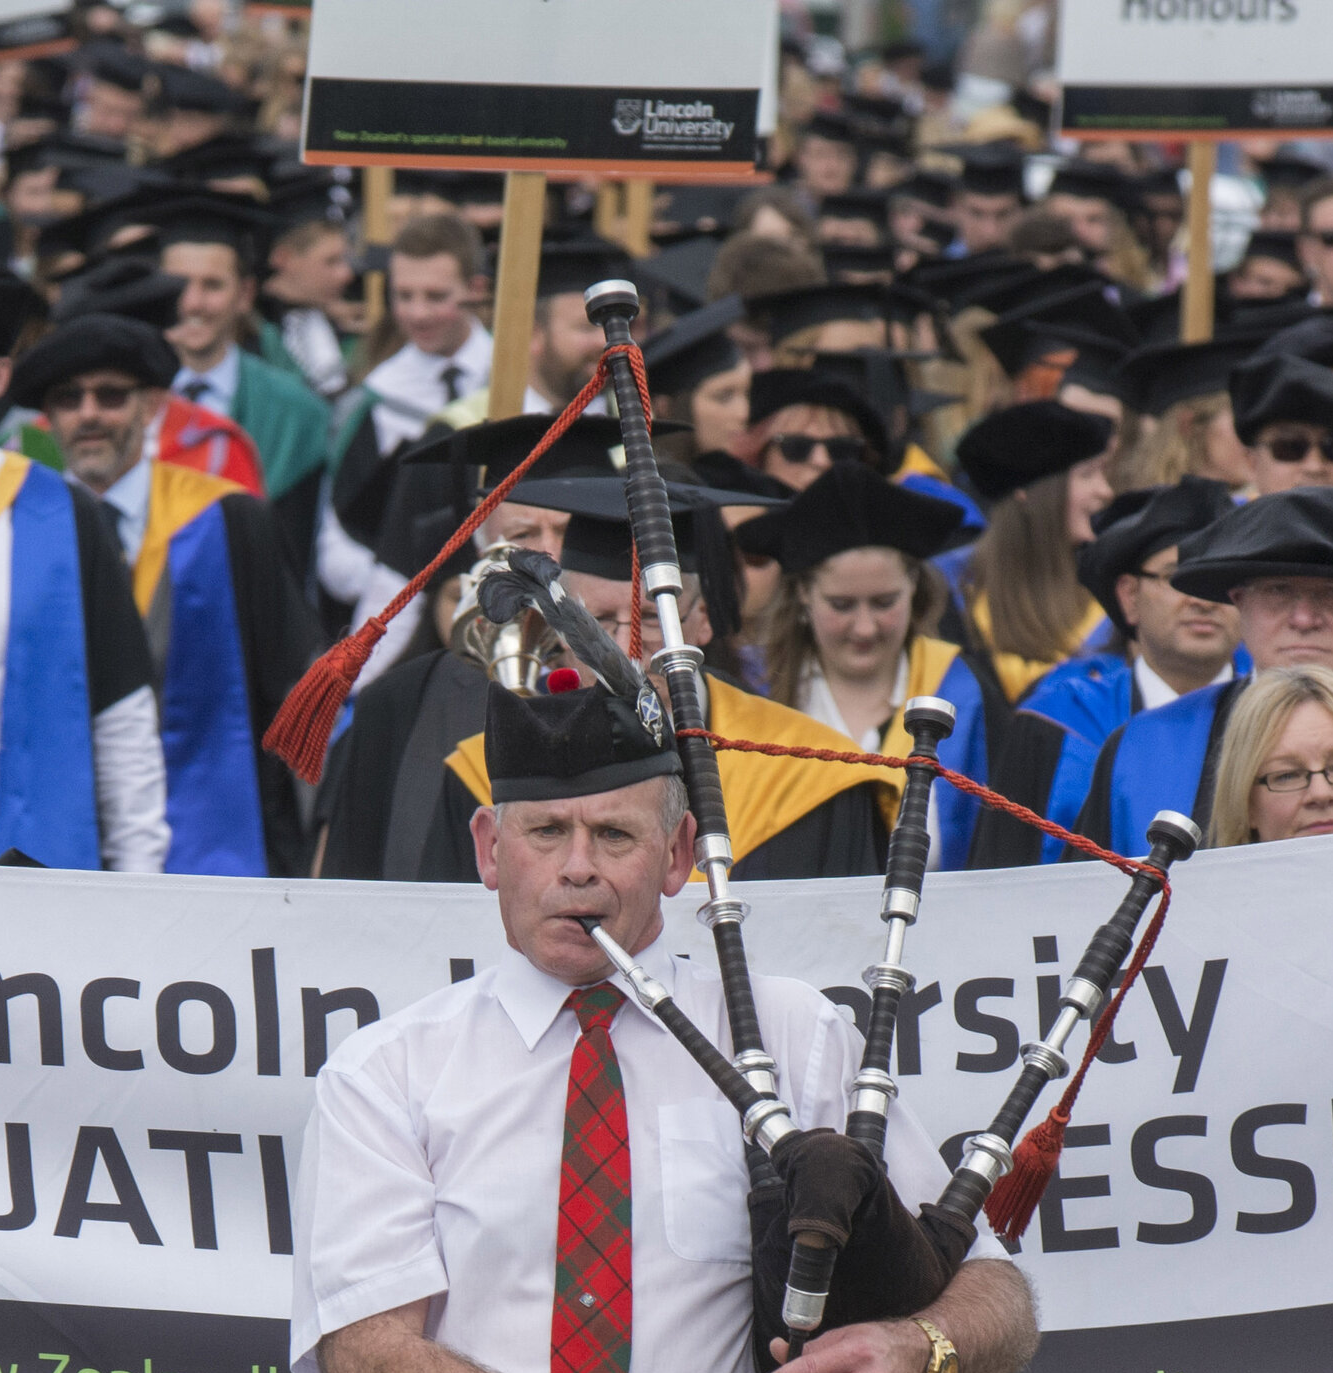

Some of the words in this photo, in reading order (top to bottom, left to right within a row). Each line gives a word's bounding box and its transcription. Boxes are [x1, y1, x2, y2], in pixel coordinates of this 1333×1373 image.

[1121, 0, 1297, 22] Honours
[644, 99, 714, 118] Lincoln
[643, 116, 735, 140] University
